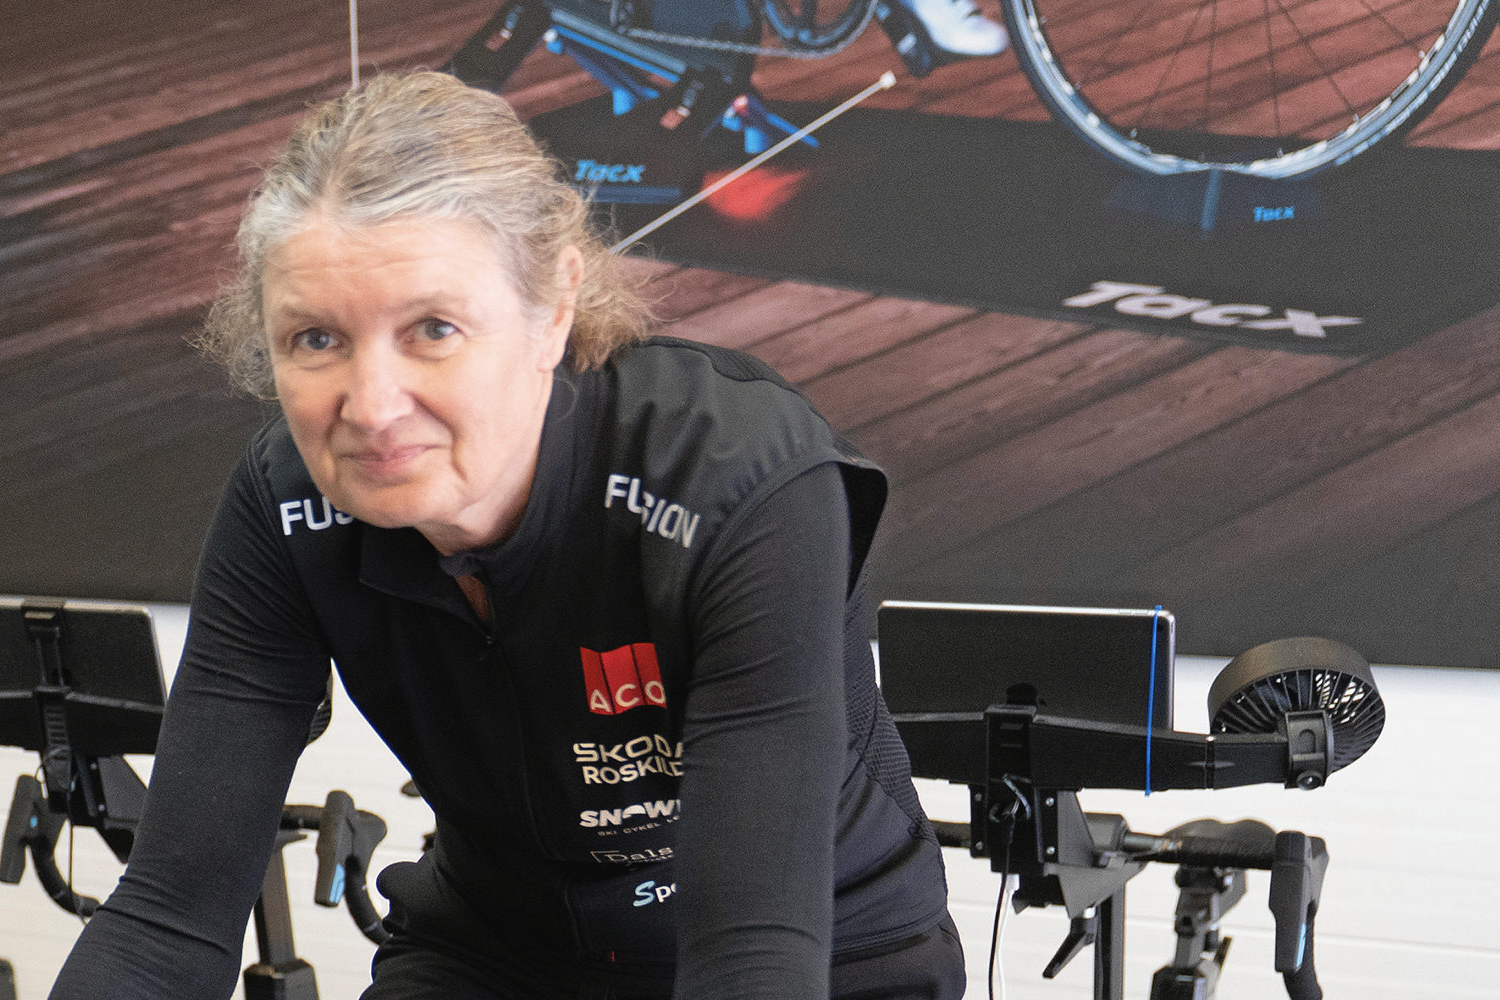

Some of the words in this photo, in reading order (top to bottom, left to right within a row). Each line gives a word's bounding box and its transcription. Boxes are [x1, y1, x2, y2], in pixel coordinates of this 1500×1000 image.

[575, 159, 646, 182] Tacx
[1254, 206, 1296, 222] Tacx
[1063, 281, 1364, 338] Tacx
[590, 680, 667, 713] ACO
